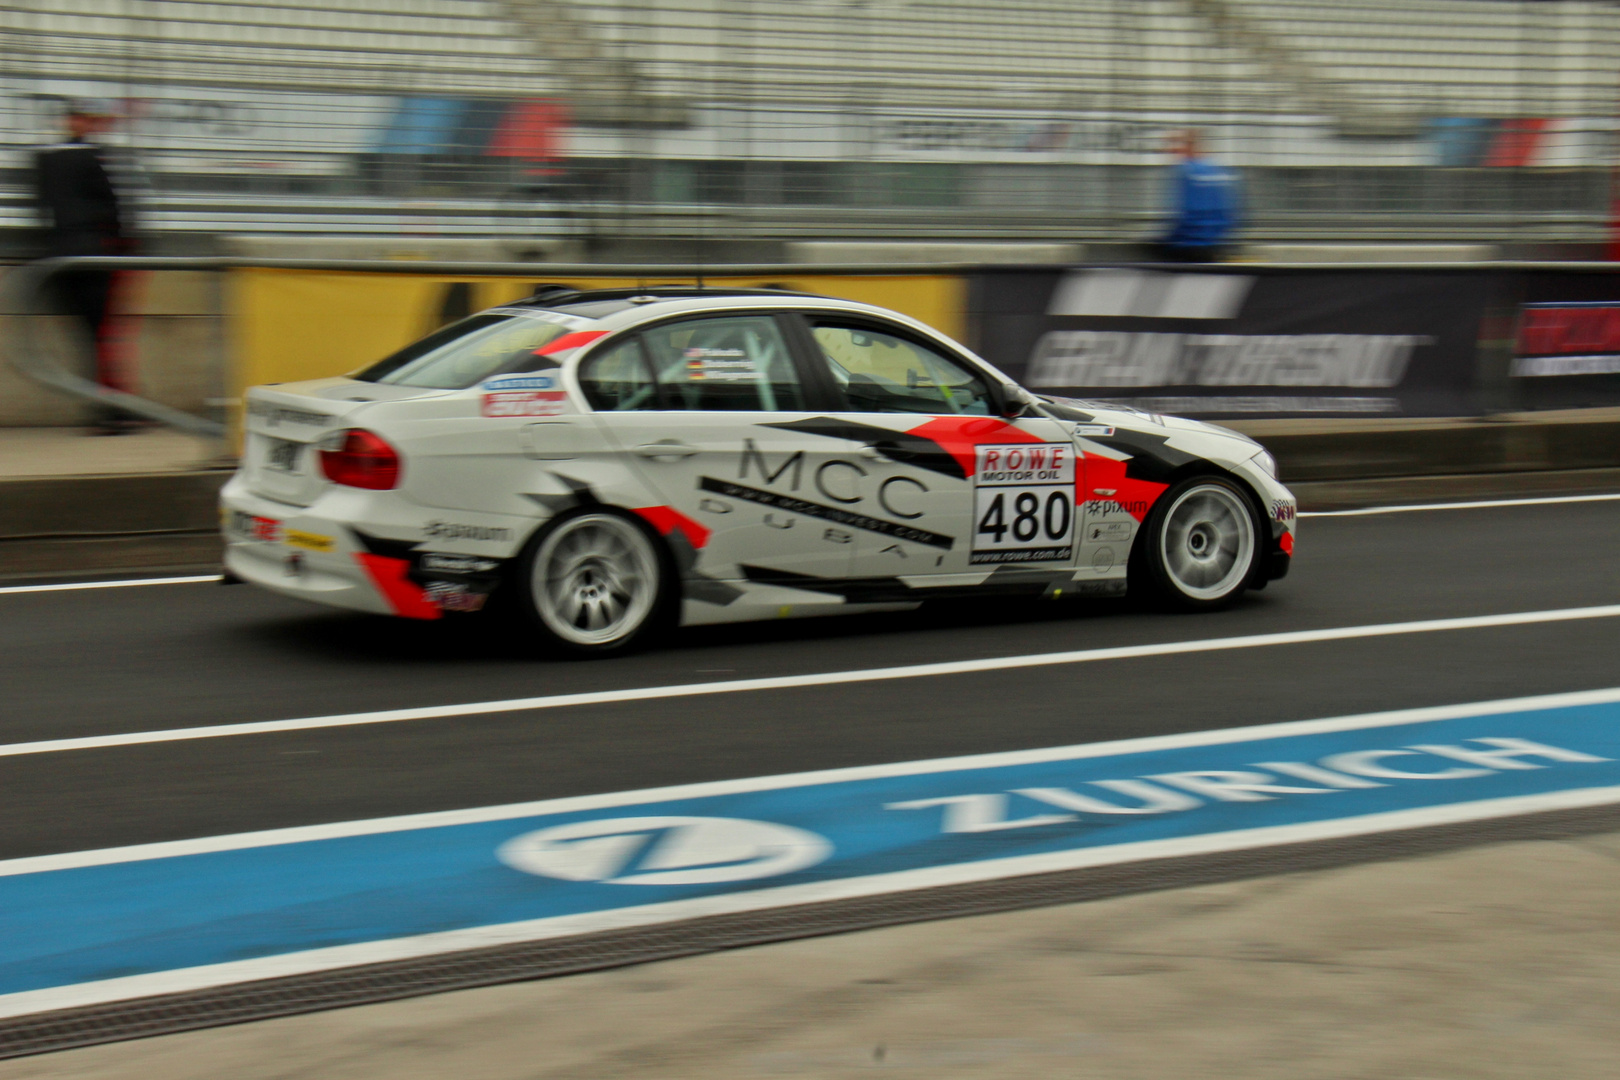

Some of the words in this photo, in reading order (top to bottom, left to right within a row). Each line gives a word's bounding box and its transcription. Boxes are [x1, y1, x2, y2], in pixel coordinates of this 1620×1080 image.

[981, 471, 1033, 481] MOTOR
[1037, 470, 1060, 480] OIL
[983, 448, 1064, 471] ROWE
[738, 438, 930, 520] MCC
[977, 490, 1071, 543] 480
[1103, 500, 1148, 517] pixum
[698, 498, 944, 567] DUBAI
[970, 547, 1071, 563] www.rowe.com.de
[883, 737, 1616, 833] ZURICH
